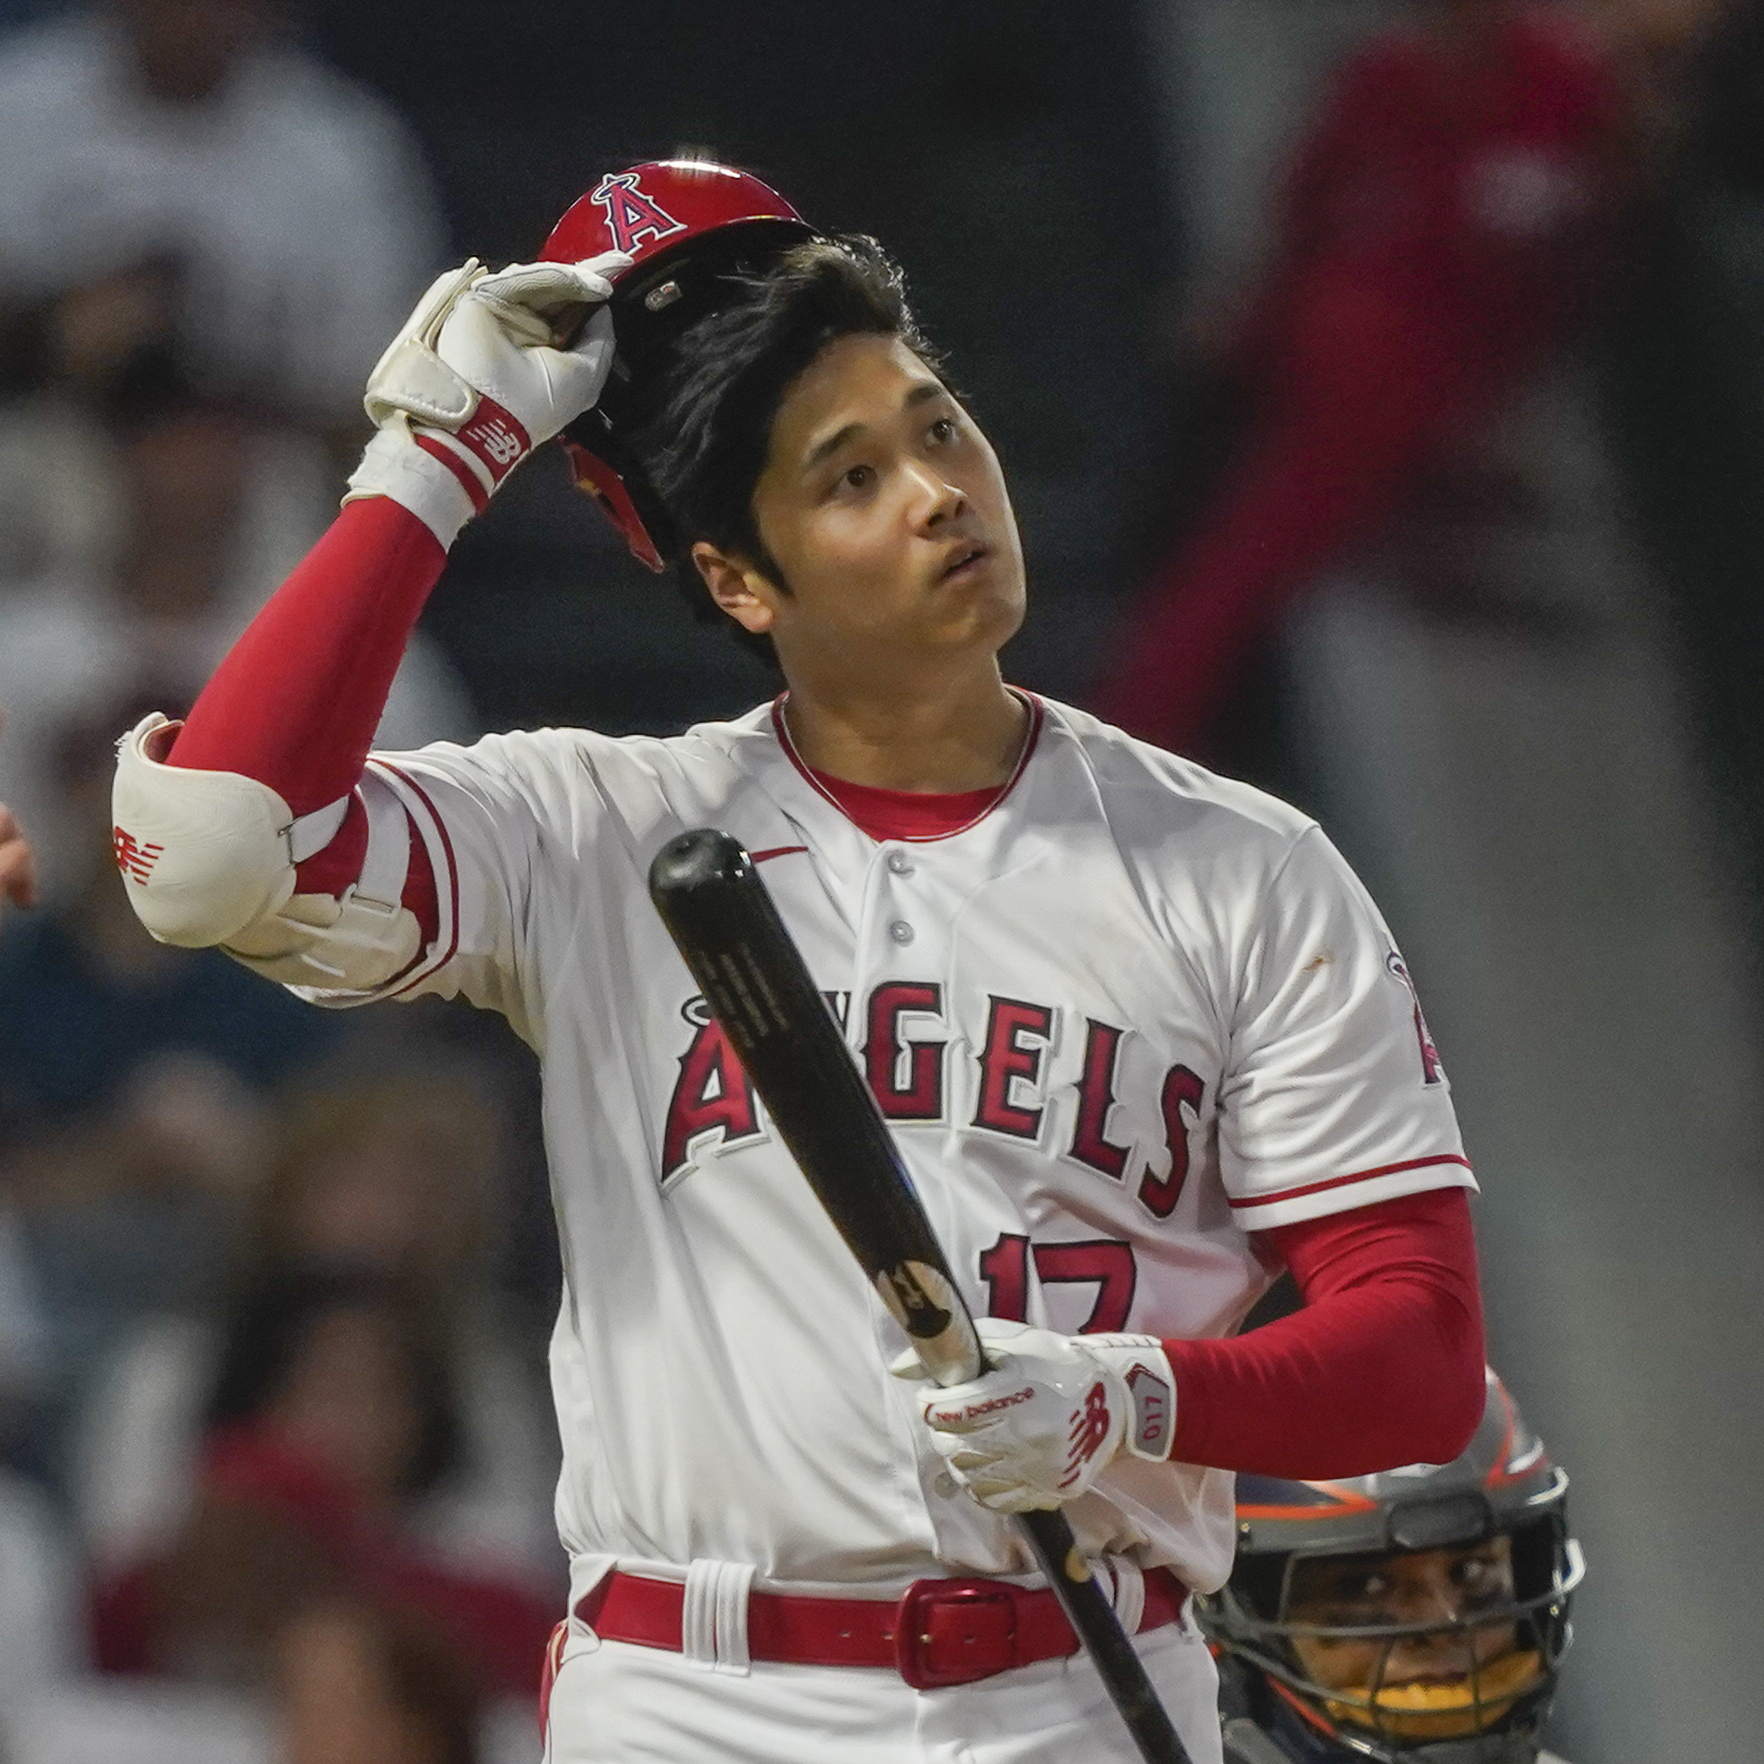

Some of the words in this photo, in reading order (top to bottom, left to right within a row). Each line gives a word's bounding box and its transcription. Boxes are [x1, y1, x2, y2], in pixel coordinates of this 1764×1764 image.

[591, 173, 687, 256] A
[660, 980, 1207, 1220] AGELS
[980, 1233, 1135, 1334] 17
[966, 1386, 1036, 1420] balance
